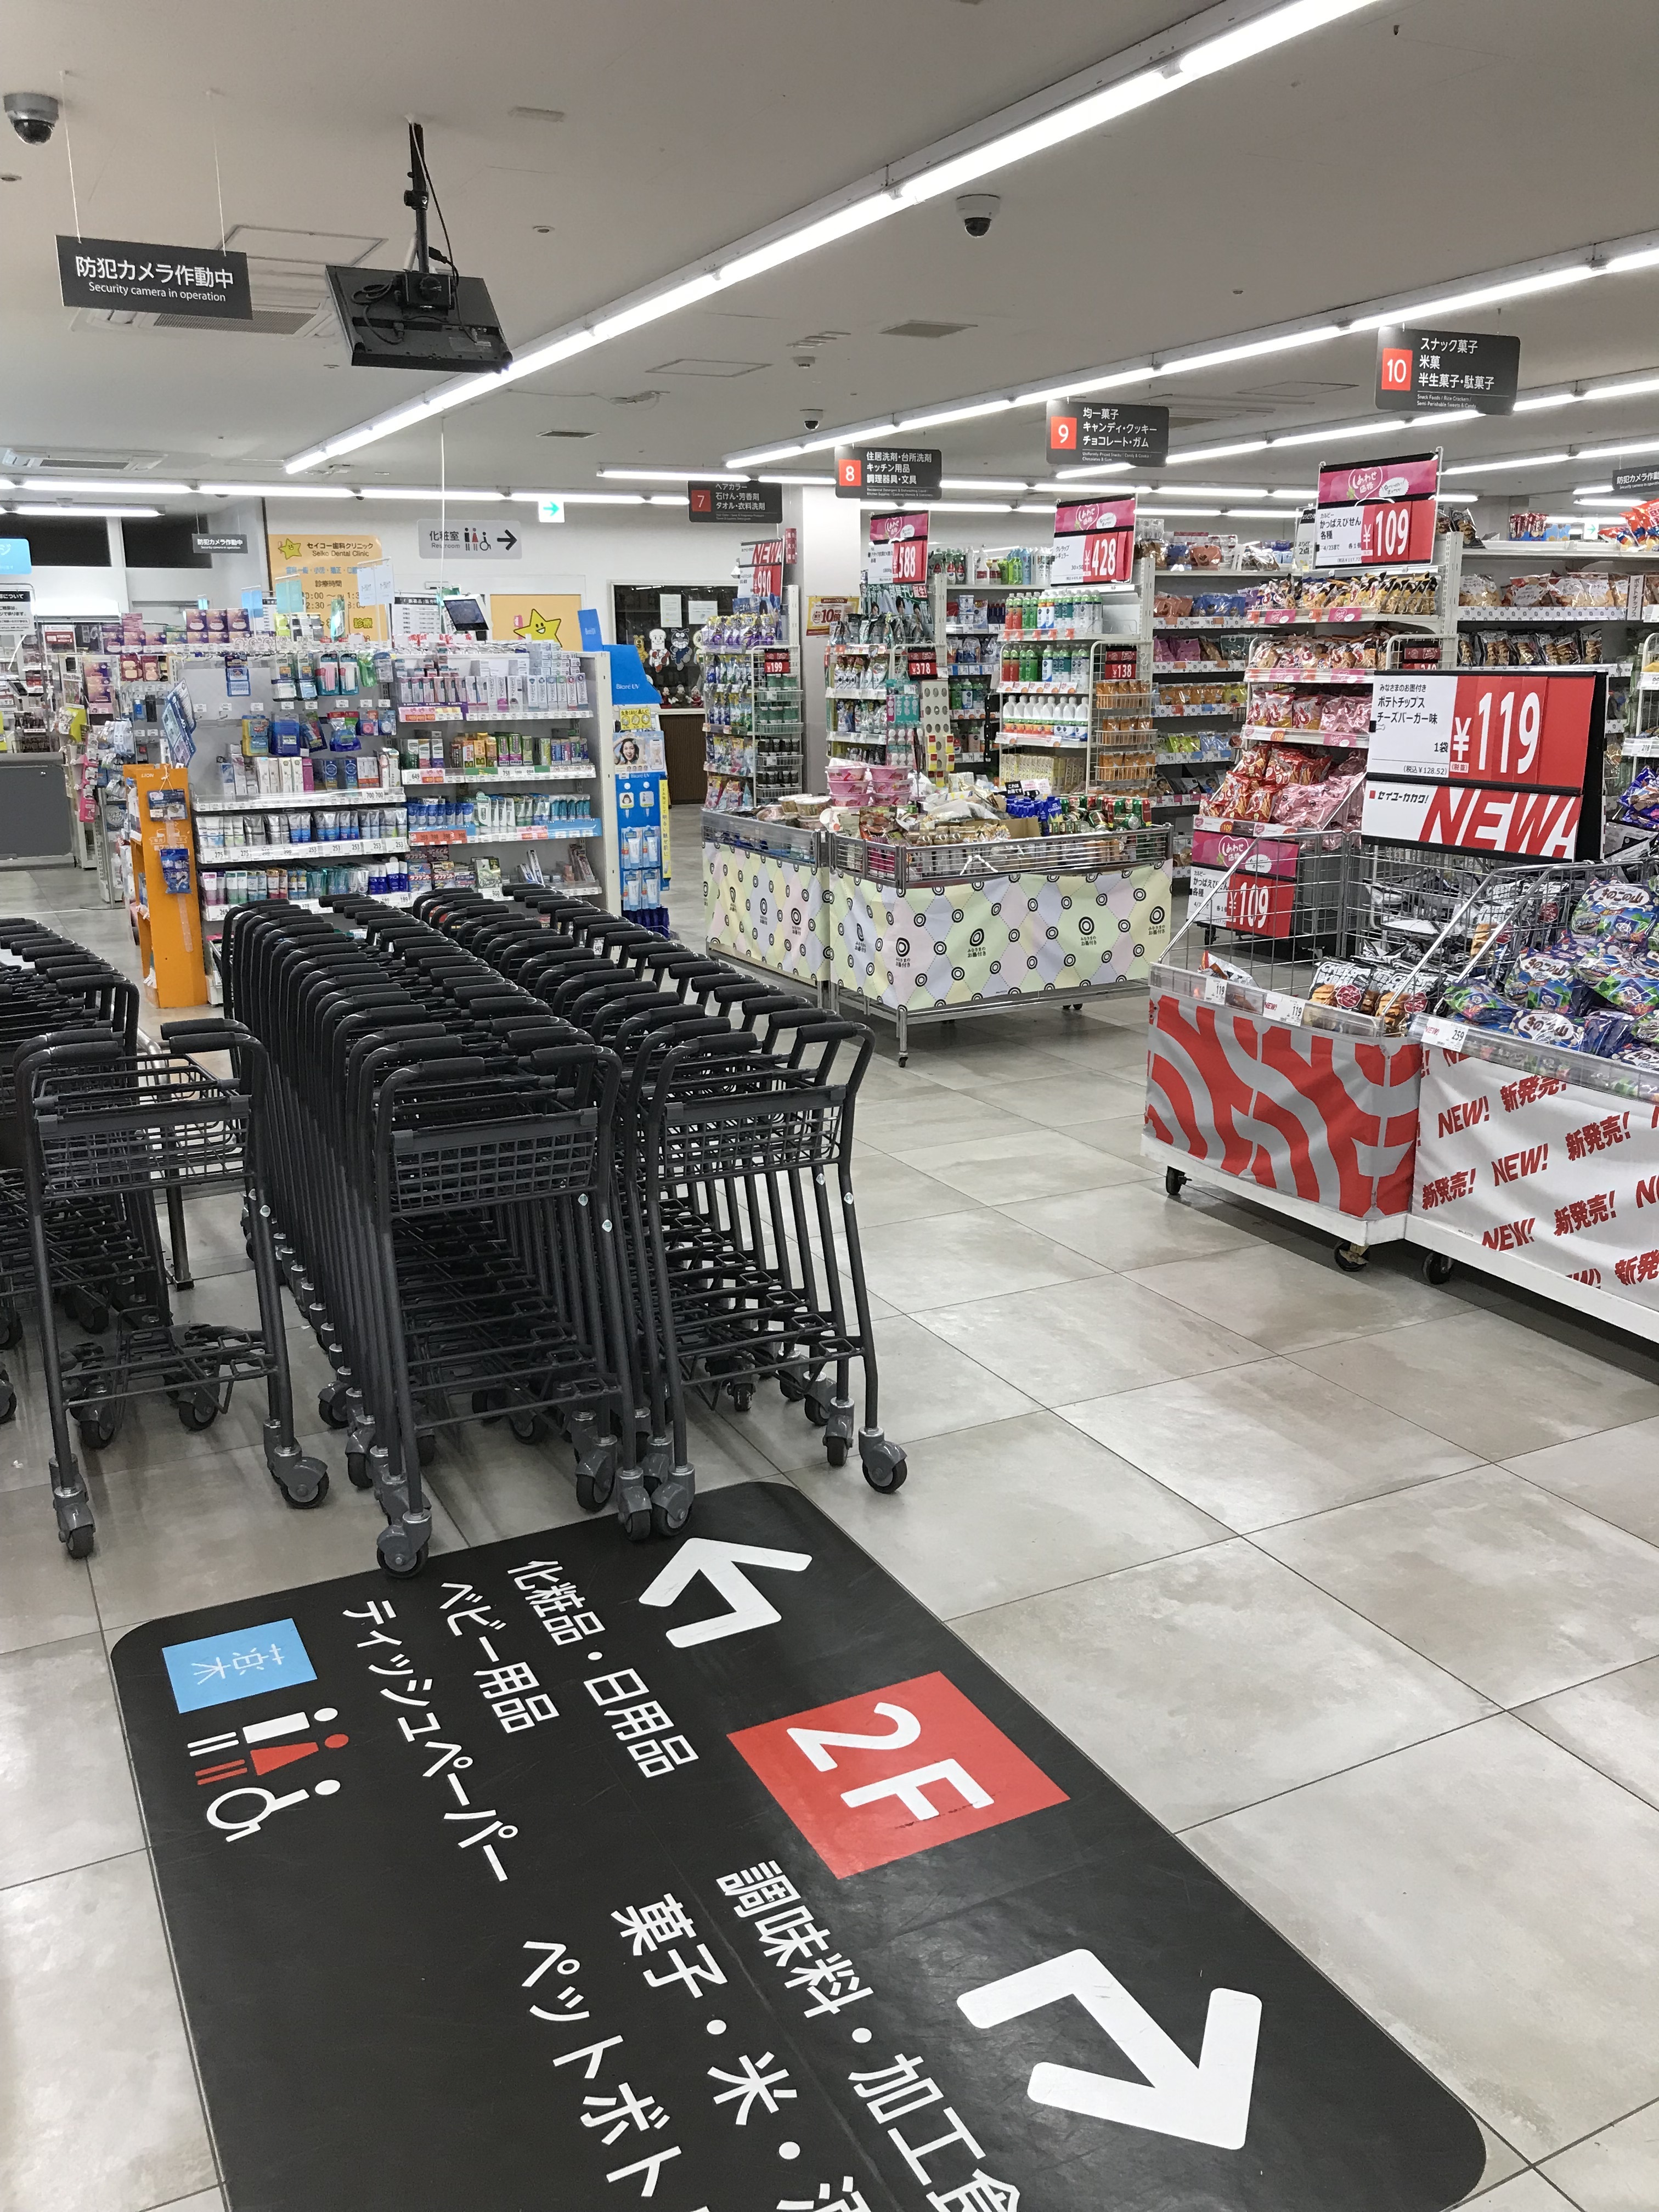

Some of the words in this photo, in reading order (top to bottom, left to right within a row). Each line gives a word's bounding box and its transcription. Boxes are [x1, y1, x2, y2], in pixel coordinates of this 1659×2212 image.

[75, 256, 234, 289] 防犯カメラ作動中
[88, 282, 128, 296] Security
[131, 287, 166, 297] camera
[168, 287, 178, 298] in
[180, 290, 226, 302] operation
[1420, 337, 1479, 354] スナック菓子
[1419, 354, 1441, 370] 米菓
[1387, 359, 1406, 383] 10
[1418, 372, 1495, 391] 半生菓子・駄菓子
[1083, 407, 1119, 420] 均一菓子
[1058, 424, 1069, 444] 9
[1083, 422, 1157, 435] キャンディ・クッキー
[1083, 435, 1149, 448] チョコレート・ガム
[866, 452, 932, 462] 住居洗剤・台所洗剤
[845, 466, 855, 482] 8
[866, 463, 910, 473] キッチン用品
[867, 474, 917, 484] 調理器具・文具
[1353, 471, 1377, 489] しあわせ
[1360, 483, 1374, 493] 価格
[697, 495, 705, 508] 7
[715, 492, 760, 501] 石けん・芳香剤
[716, 503, 765, 511] タオル・衣料洗剤
[1319, 517, 1361, 529] かっぱえびせん
[430, 531, 459, 541] 化粧室
[1321, 530, 1333, 540] 各種
[353, 618, 373, 628] 診療
[1379, 684, 1426, 692] みなさまのお墨付き
[1378, 695, 1425, 709] ポテトチップス
[1376, 712, 1438, 725] チーズバーガー味
[1434, 742, 1448, 753] 1袋
[1222, 842, 1244, 856] しあわせ
[1193, 877, 1229, 890] かっぱえびん
[1193, 887, 1204, 897] 各種
[1599, 887, 1644, 904] きのこの山
[1525, 958, 1568, 976] きのこの山
[1216, 985, 1224, 995] 119
[1264, 1002, 1278, 1011] NEW!
[1292, 1006, 1302, 1017] 119
[1452, 1030, 1465, 1041] 259
[1438, 1096, 1489, 1138] NEW!
[1565, 1110, 1631, 1161] 新発売!
[1491, 1143, 1549, 1187] NEW!
[1422, 1167, 1476, 1210] 新発売!
[1554, 1190, 1617, 1237] 新発売!
[1482, 1217, 1536, 1251] NEW!
[441, 1582, 559, 1734] ベビー用品
[508, 1559, 699, 1779] 化粧品・日用品
[342, 1599, 518, 1882] ティッシュペーパー
[786, 1702, 995, 1821] 2F
[522, 1940, 710, 2212] ペットボト
